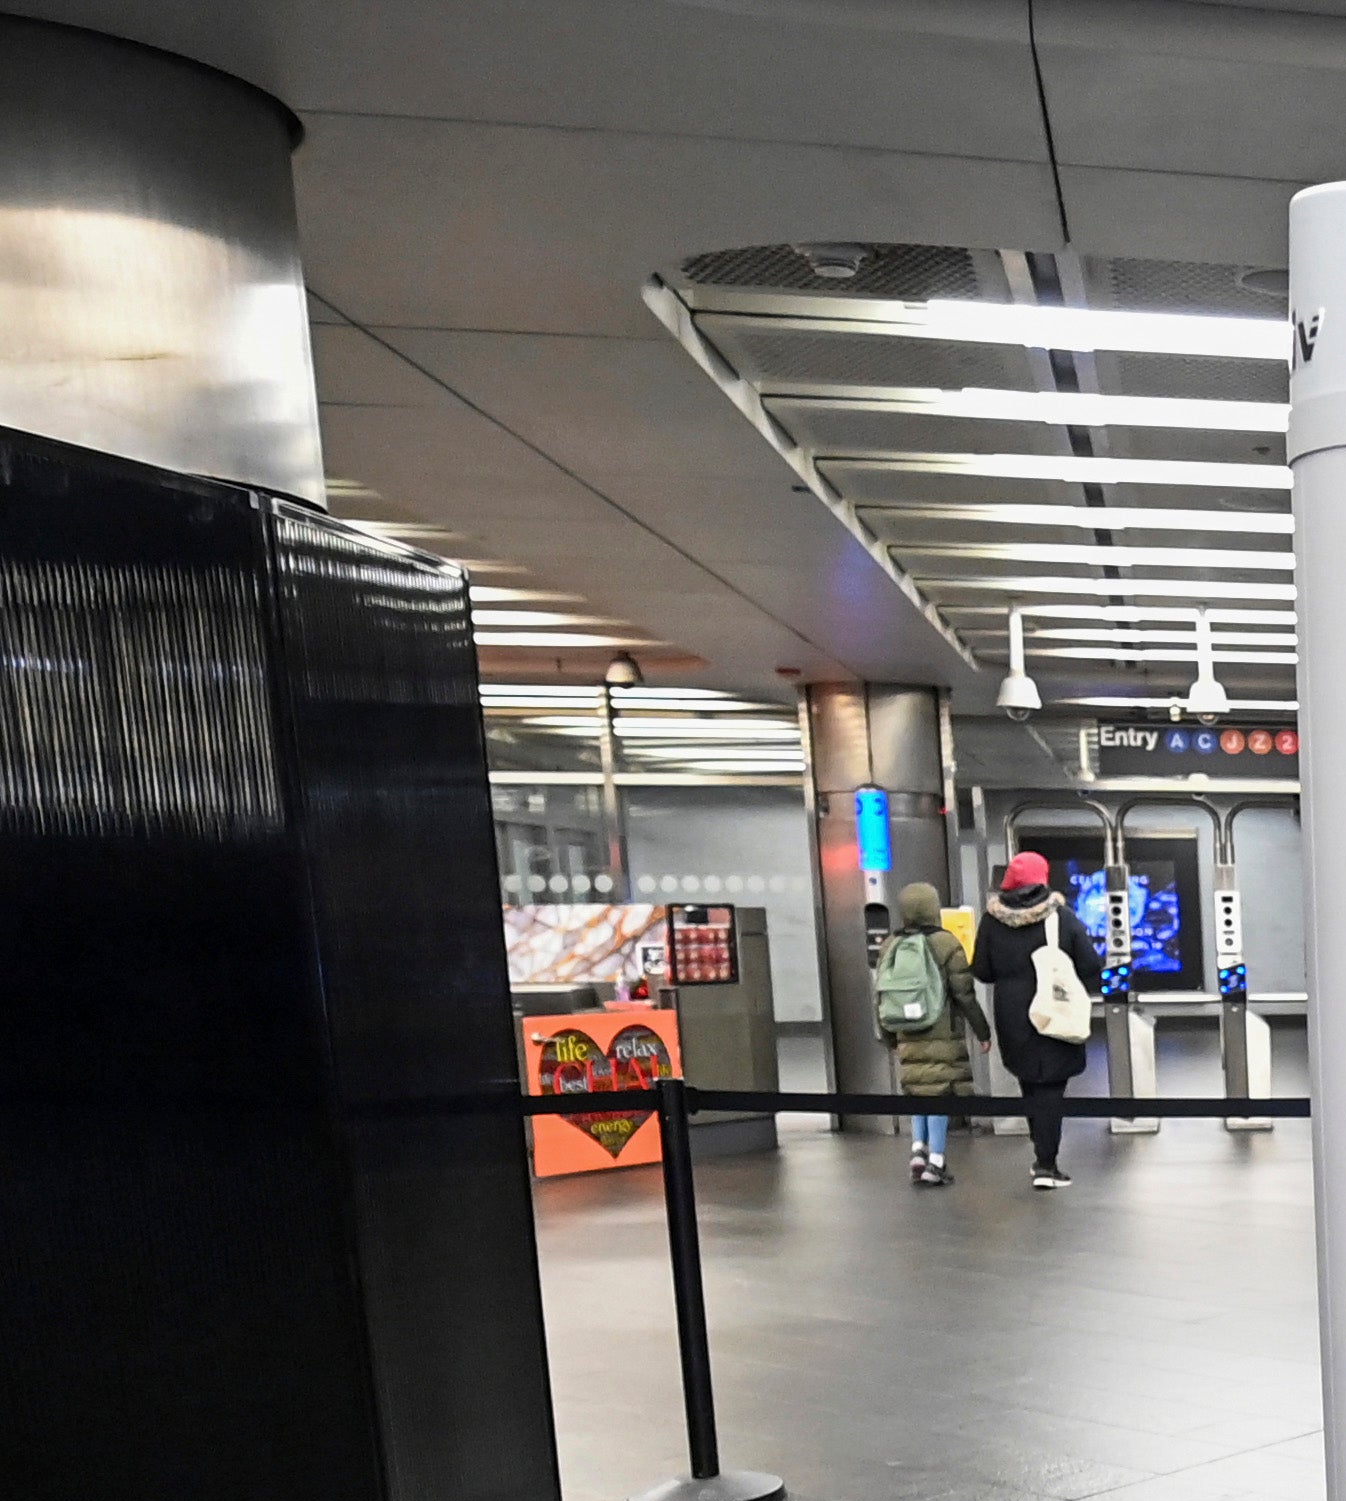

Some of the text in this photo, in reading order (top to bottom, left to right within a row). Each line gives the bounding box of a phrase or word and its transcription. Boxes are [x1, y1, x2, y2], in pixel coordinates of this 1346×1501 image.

[1101, 726, 1158, 750] Entry
[555, 1034, 588, 1062] life
[615, 1037, 658, 1060] relax
[590, 1118, 634, 1135] energy
